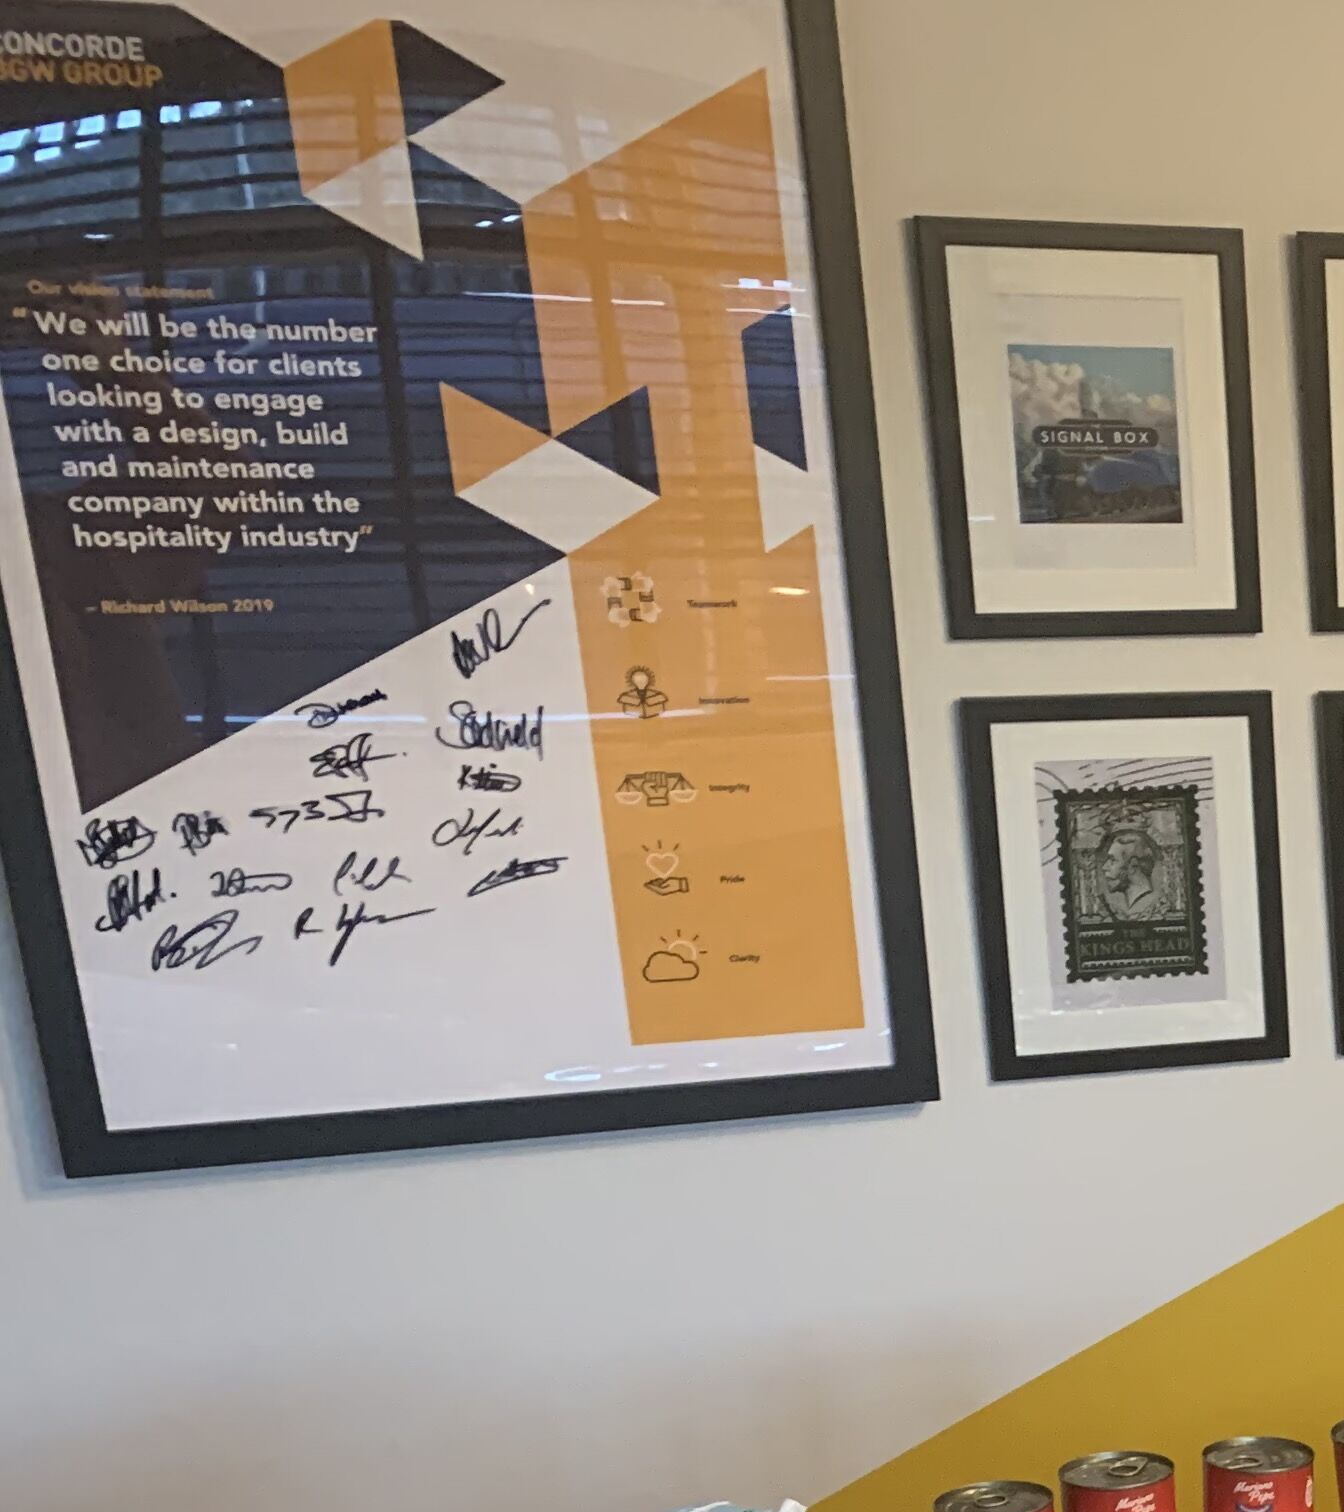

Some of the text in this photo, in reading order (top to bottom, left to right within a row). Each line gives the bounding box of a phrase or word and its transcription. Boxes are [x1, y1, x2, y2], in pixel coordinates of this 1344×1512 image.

[0, 30, 145, 62] ONCORDE
[63, 61, 163, 88] GROUP
[97, 312, 150, 337] will
[159, 314, 198, 339] be
[206, 316, 257, 341] the
[267, 318, 378, 344] number
[42, 349, 363, 379] one choice for clients
[47, 383, 324, 418] looking to engage
[54, 420, 350, 451] with a design, build
[1040, 430, 1149, 444] SIGNAL BOX
[62, 454, 315, 481] and maintenance
[68, 491, 361, 519] company within the
[73, 525, 232, 554] hospitality
[101, 599, 274, 615] Richard Wilson 2019
[720, 875, 746, 885] Pride
[1080, 938, 1190, 957] KINGS HEAD
